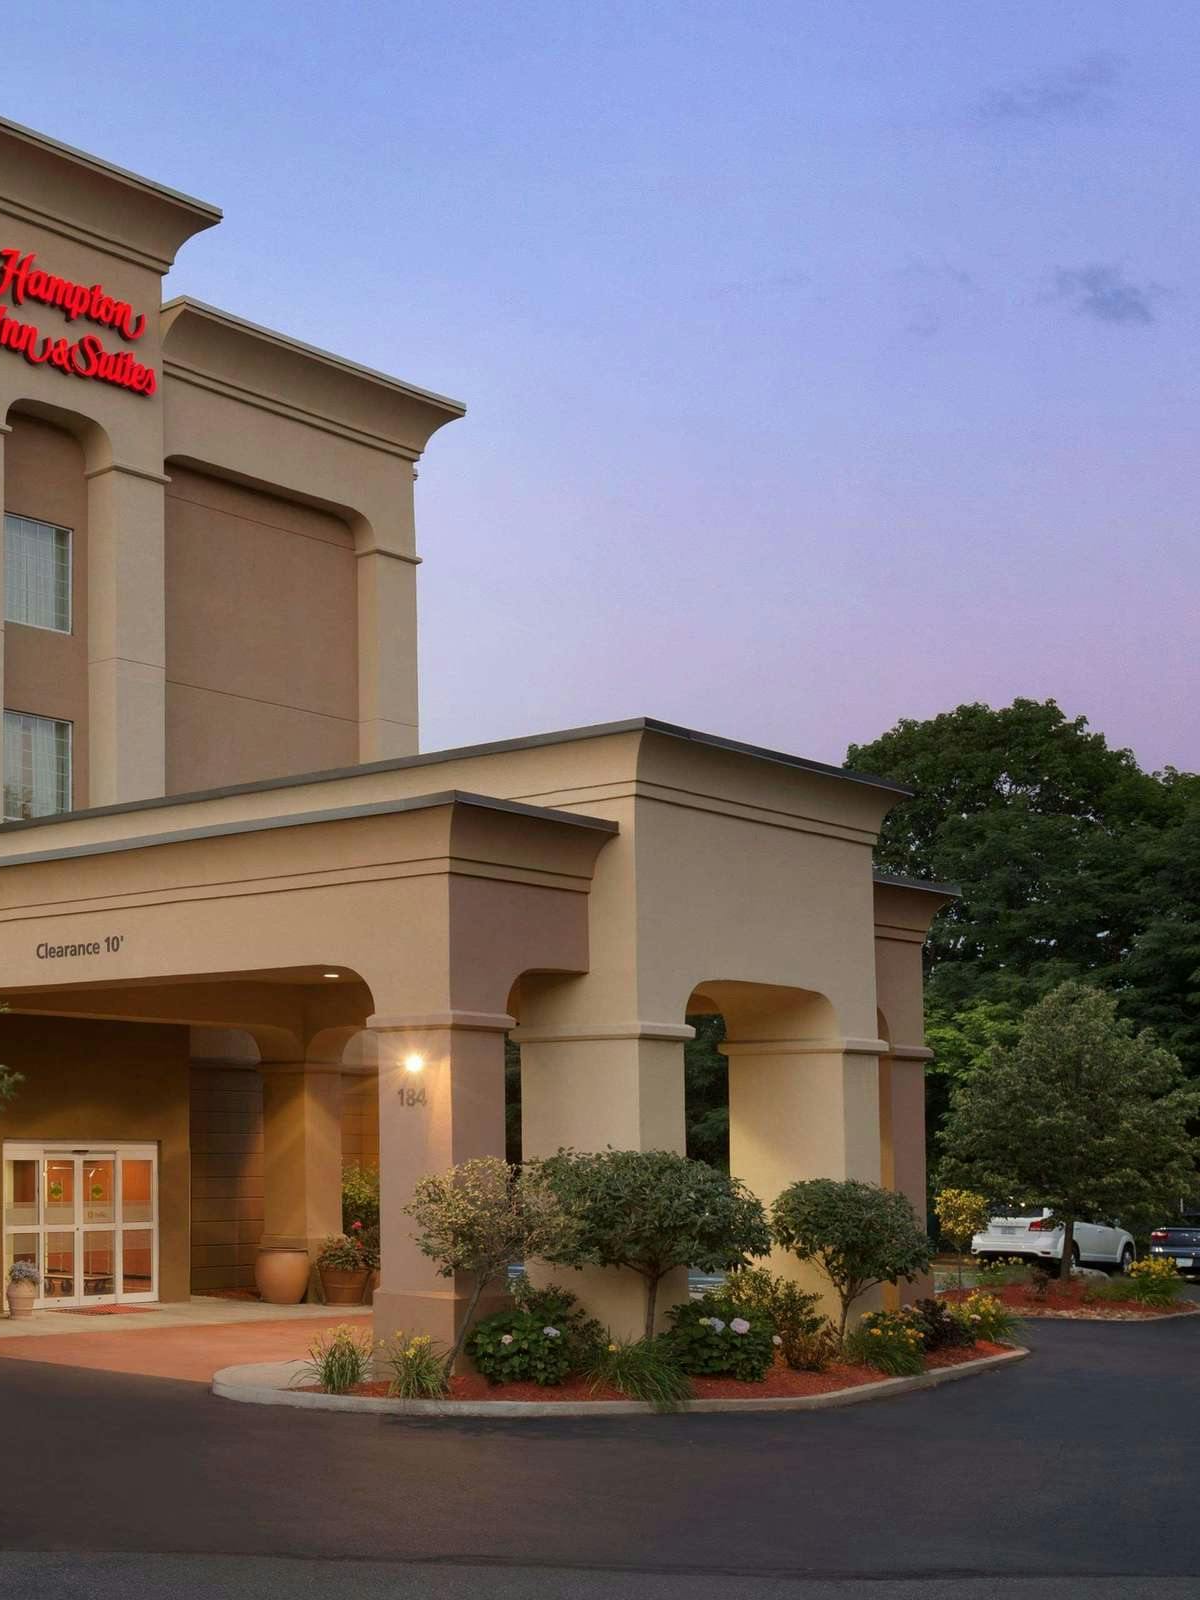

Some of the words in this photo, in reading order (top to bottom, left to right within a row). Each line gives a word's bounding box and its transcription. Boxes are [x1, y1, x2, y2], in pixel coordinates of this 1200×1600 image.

[50, 337, 73, 374] &
[71, 335, 158, 396] Suites
[36, 941, 101, 959] Clearance
[104, 935, 124, 953] 10'
[397, 1088, 428, 1107] 184
